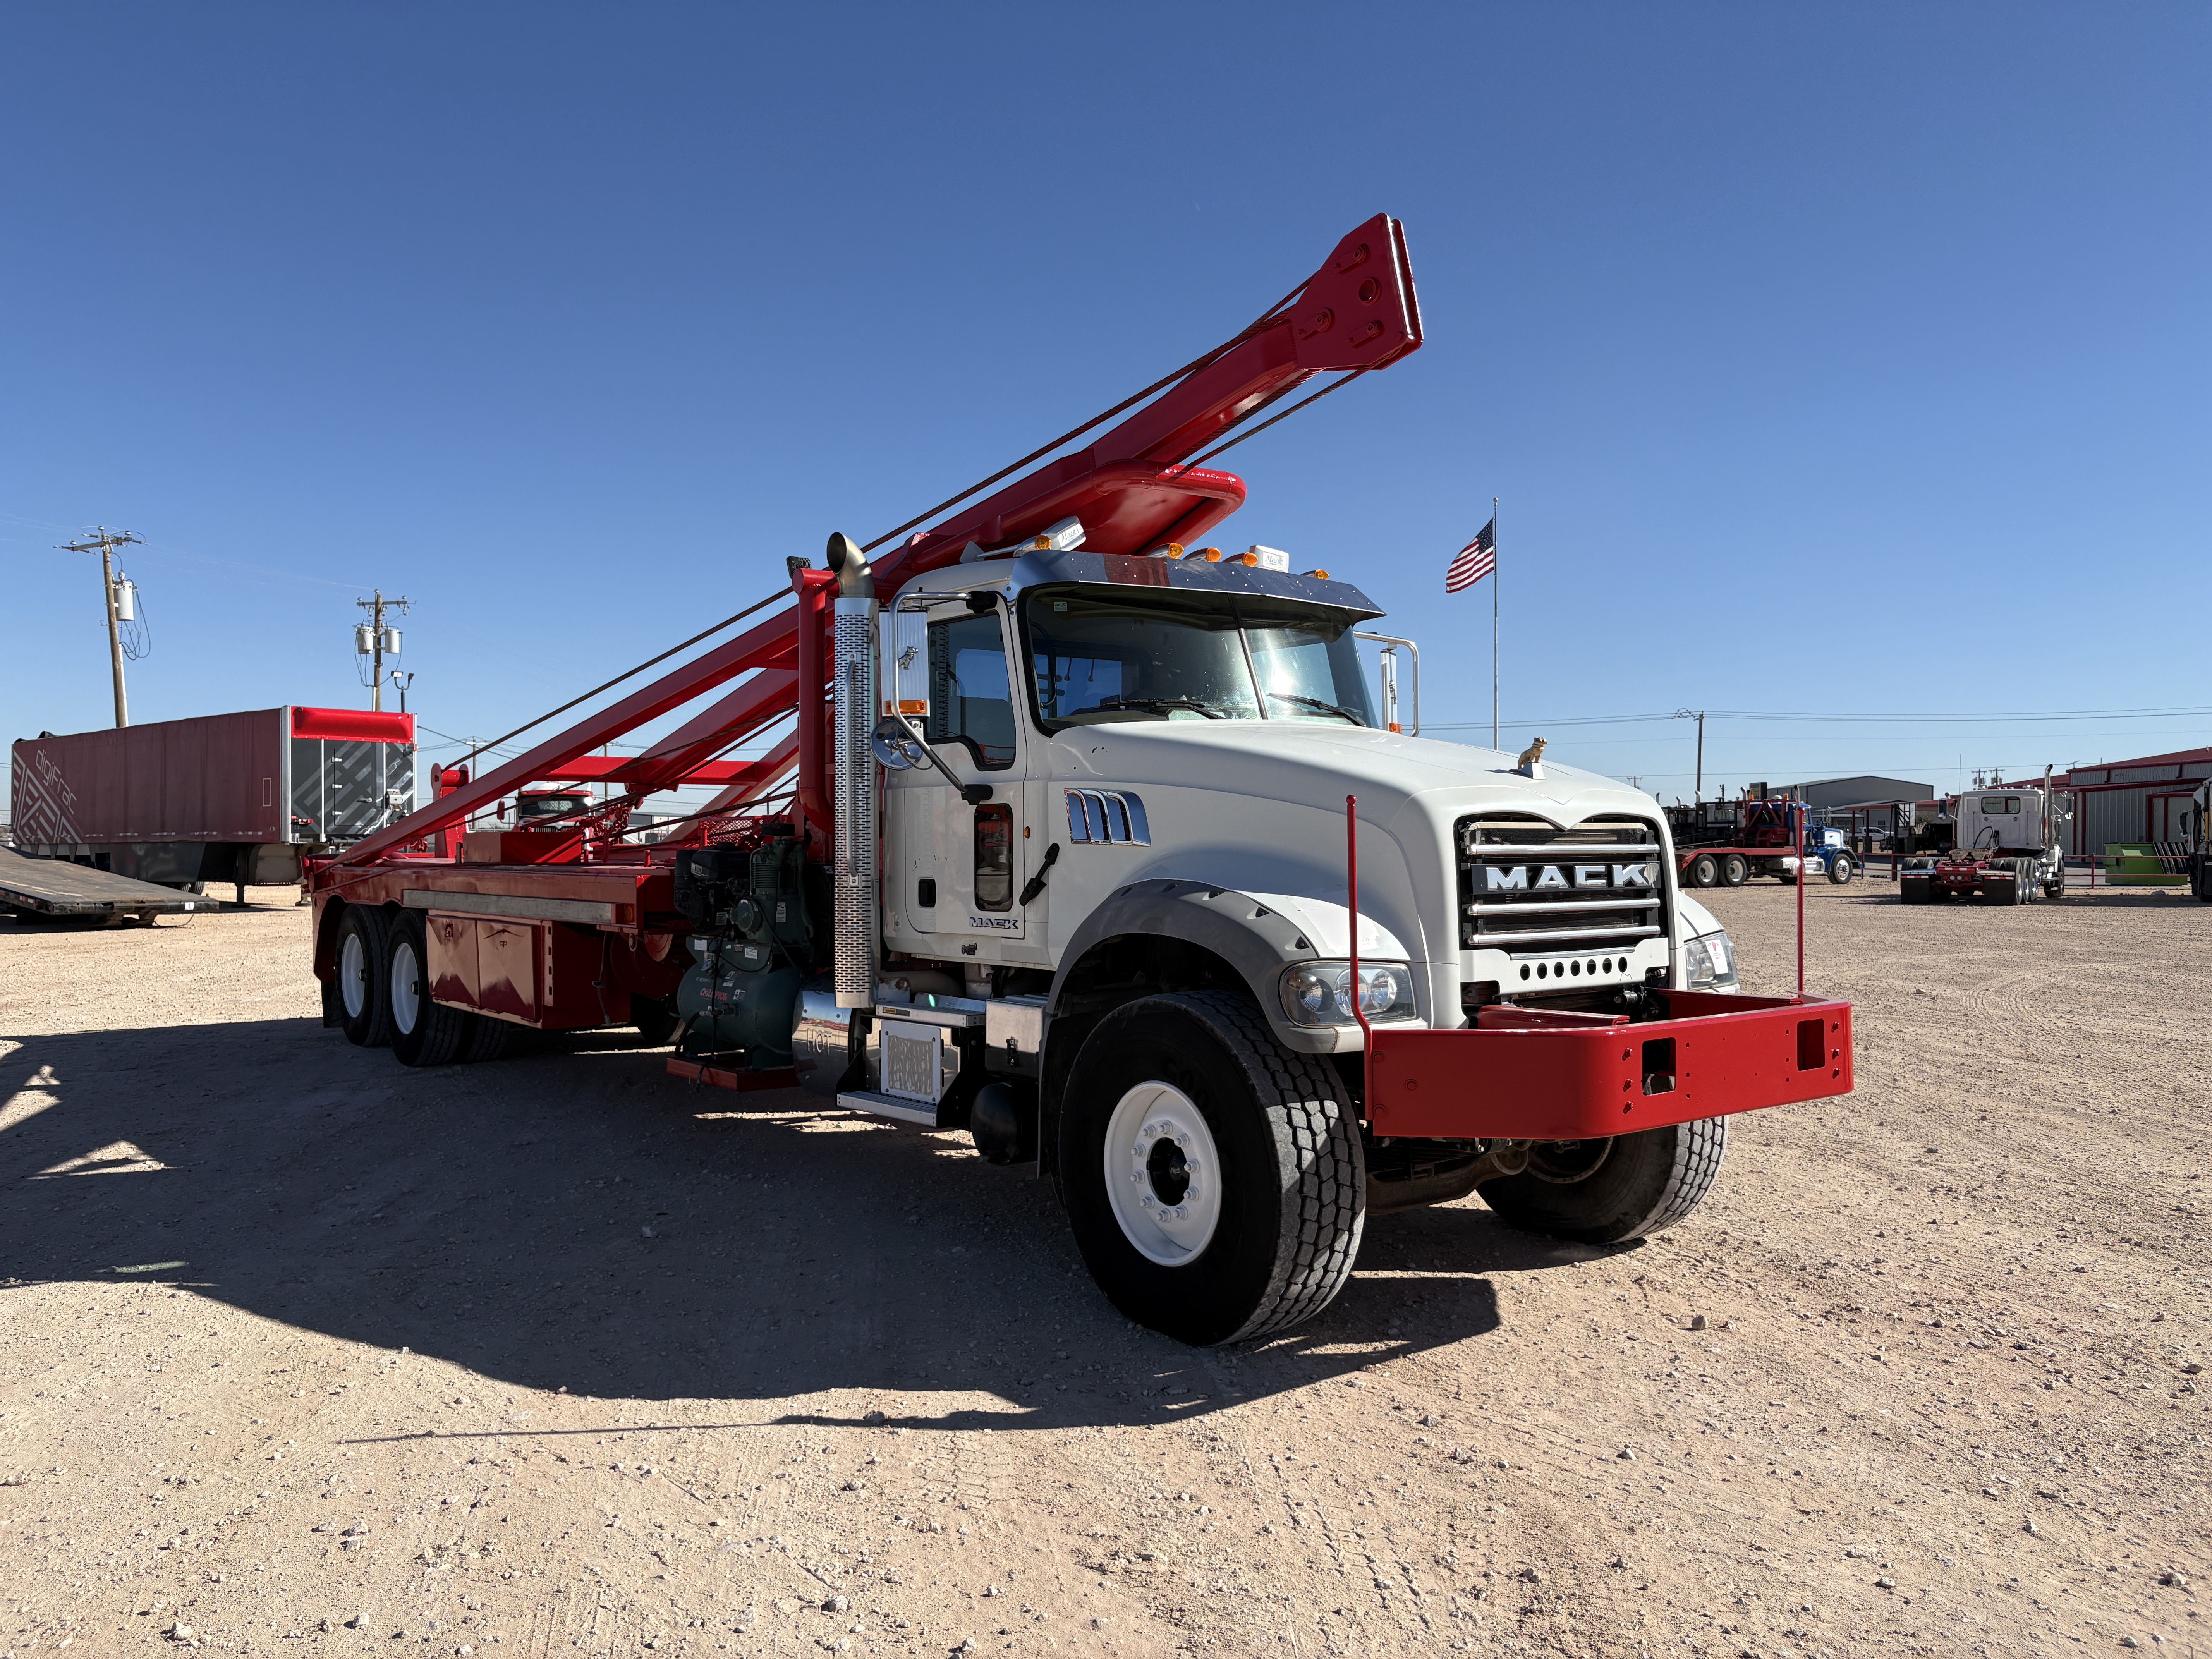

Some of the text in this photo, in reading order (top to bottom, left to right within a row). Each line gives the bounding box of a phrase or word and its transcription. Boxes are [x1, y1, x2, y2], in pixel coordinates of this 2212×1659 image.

[1061, 528, 1077, 542] Mack
[1486, 864, 1651, 891] MACK
[969, 917, 1018, 929] MACK
[807, 1028, 833, 1056] HOT
